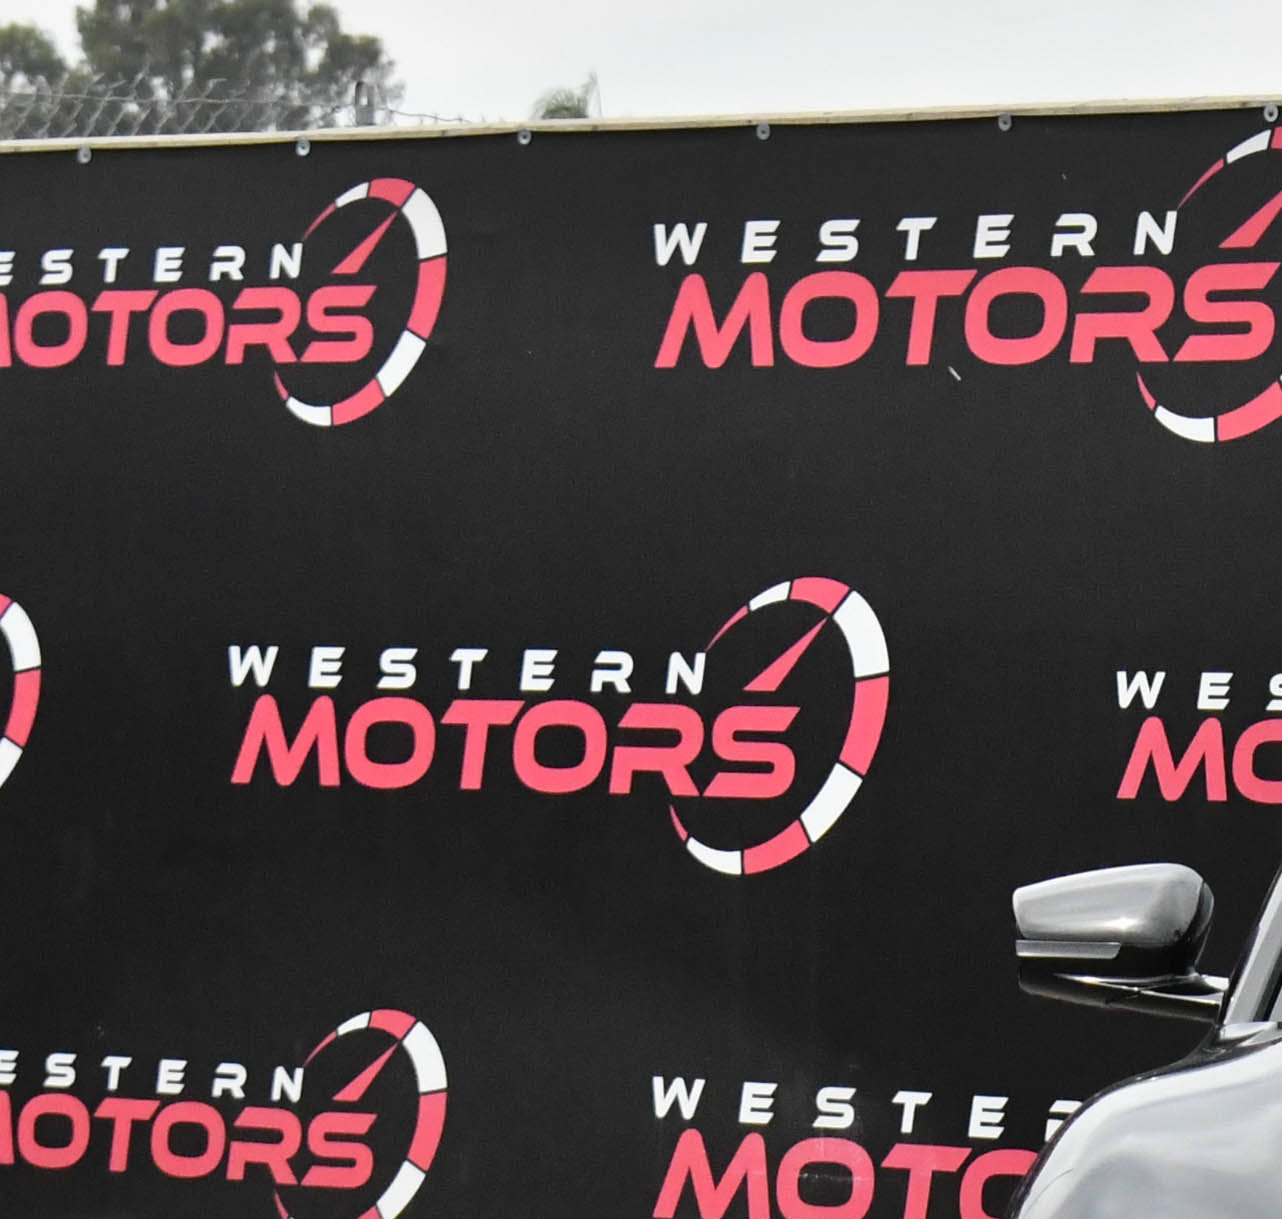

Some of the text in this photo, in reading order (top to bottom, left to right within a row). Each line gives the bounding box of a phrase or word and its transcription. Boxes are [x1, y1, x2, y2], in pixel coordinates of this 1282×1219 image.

[654, 211, 1177, 265] WESTERN
[0, 285, 376, 368] OTORS
[656, 262, 1280, 368] MOTORS
[230, 646, 706, 694] WESTERN
[232, 695, 800, 798] MOTORS
[0, 1090, 376, 1188] OTORS
